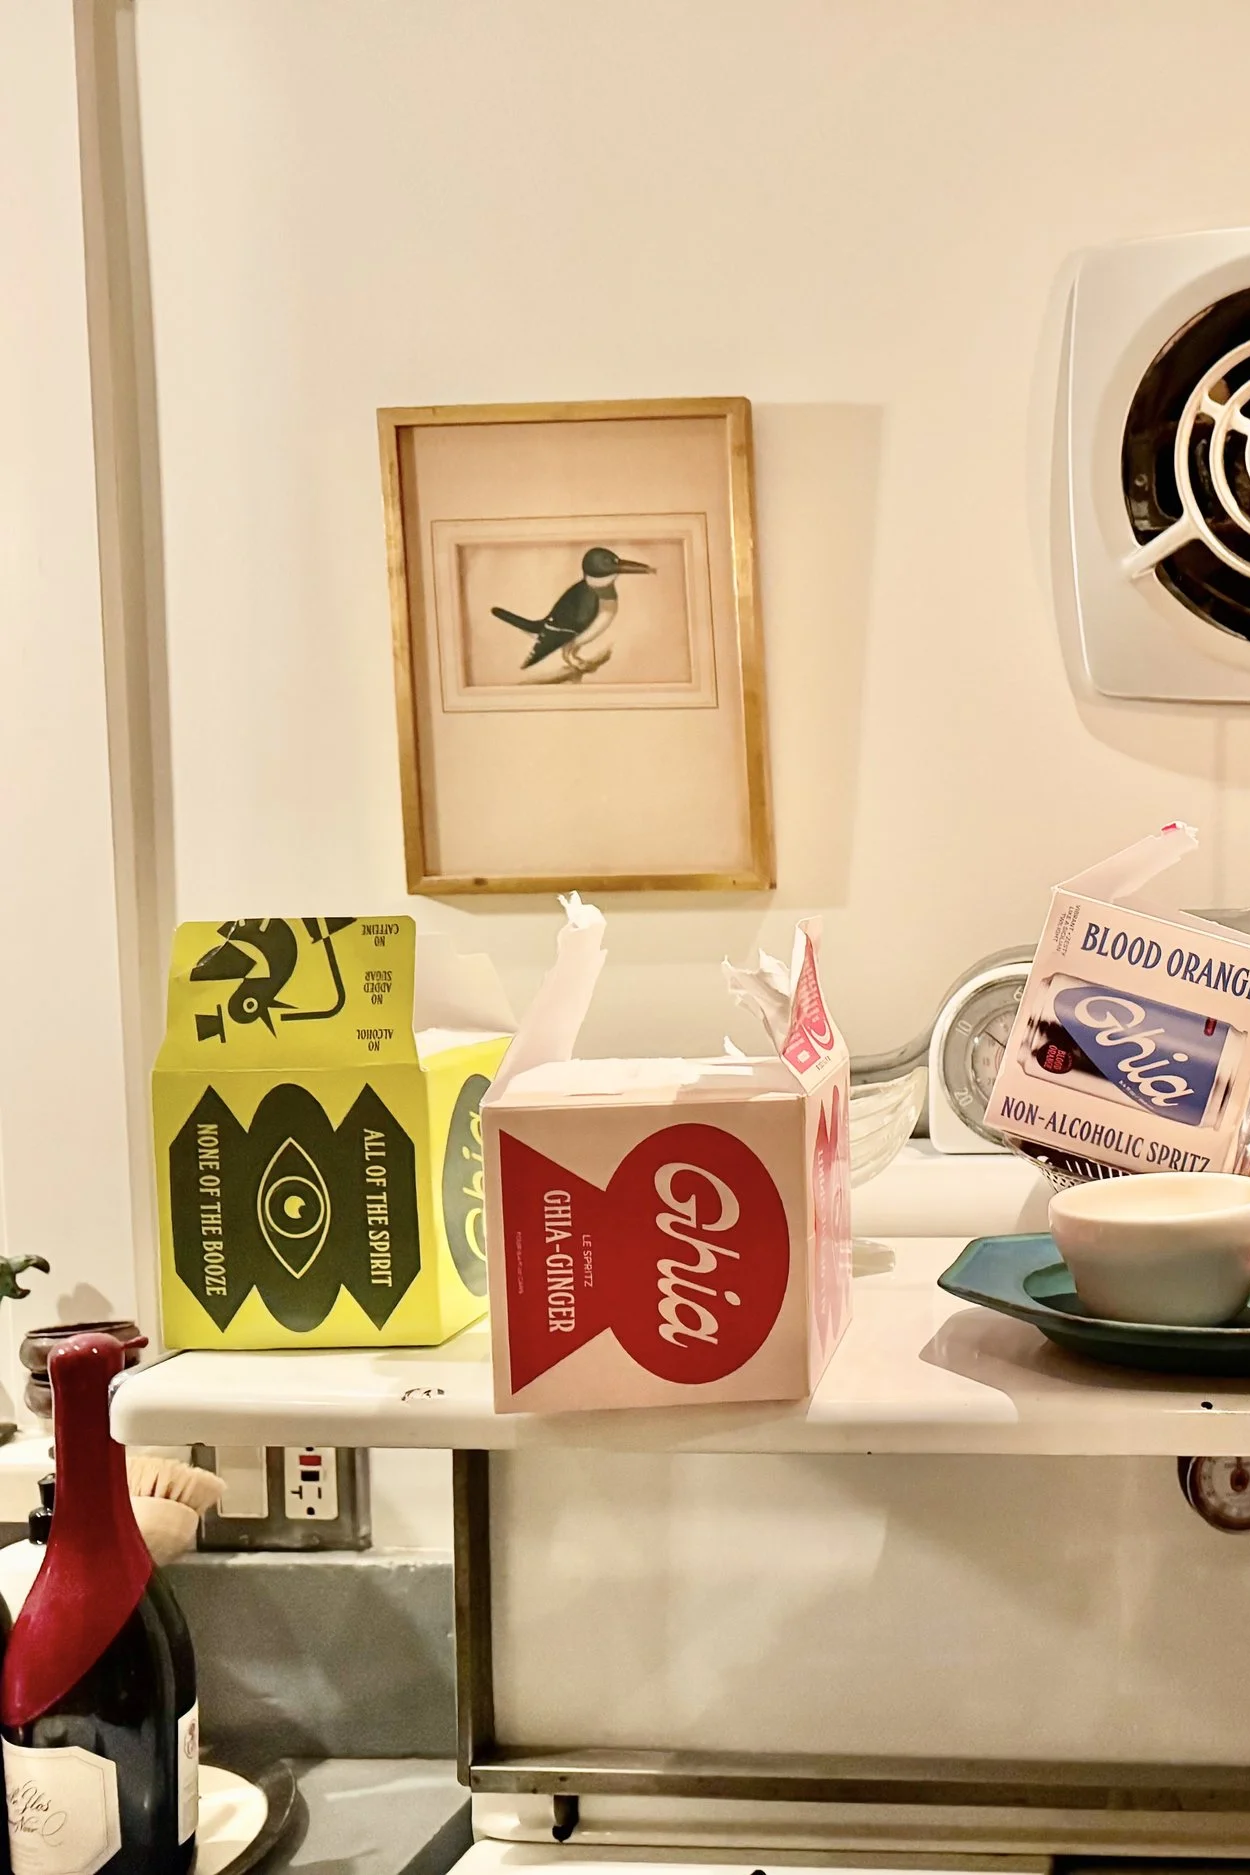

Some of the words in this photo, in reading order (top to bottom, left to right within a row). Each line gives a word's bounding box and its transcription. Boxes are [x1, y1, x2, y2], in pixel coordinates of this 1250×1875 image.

[362, 923, 399, 935] CAFFEINE
[374, 936, 385, 946] NO
[1080, 922, 1162, 970] BLOOD
[363, 982, 391, 993] ADDED
[365, 970, 392, 981] SUGAR
[371, 994, 383, 1004] NO
[356, 1029, 393, 1040] ALCOHOL
[368, 1041, 380, 1051] NO
[1074, 996, 1195, 1107] Ghia
[197, 1123, 220, 1169] NONE
[363, 1128, 385, 1163] ALL
[1001, 1096, 1145, 1159] NON-ALCOHOLIC
[1147, 1141, 1211, 1173] SPRITZ
[199, 1171, 221, 1198] OF
[366, 1165, 387, 1192] OF
[200, 1202, 223, 1237] THE
[367, 1193, 389, 1228] THE
[369, 1228, 392, 1288] SPIRIT
[582, 1233, 593, 1250] LE
[654, 1162, 741, 1349] Ghia
[203, 1239, 227, 1297] BOOZE
[543, 1189, 576, 1334] GHIA-GINGER
[582, 1251, 594, 1288] SPRITZ
